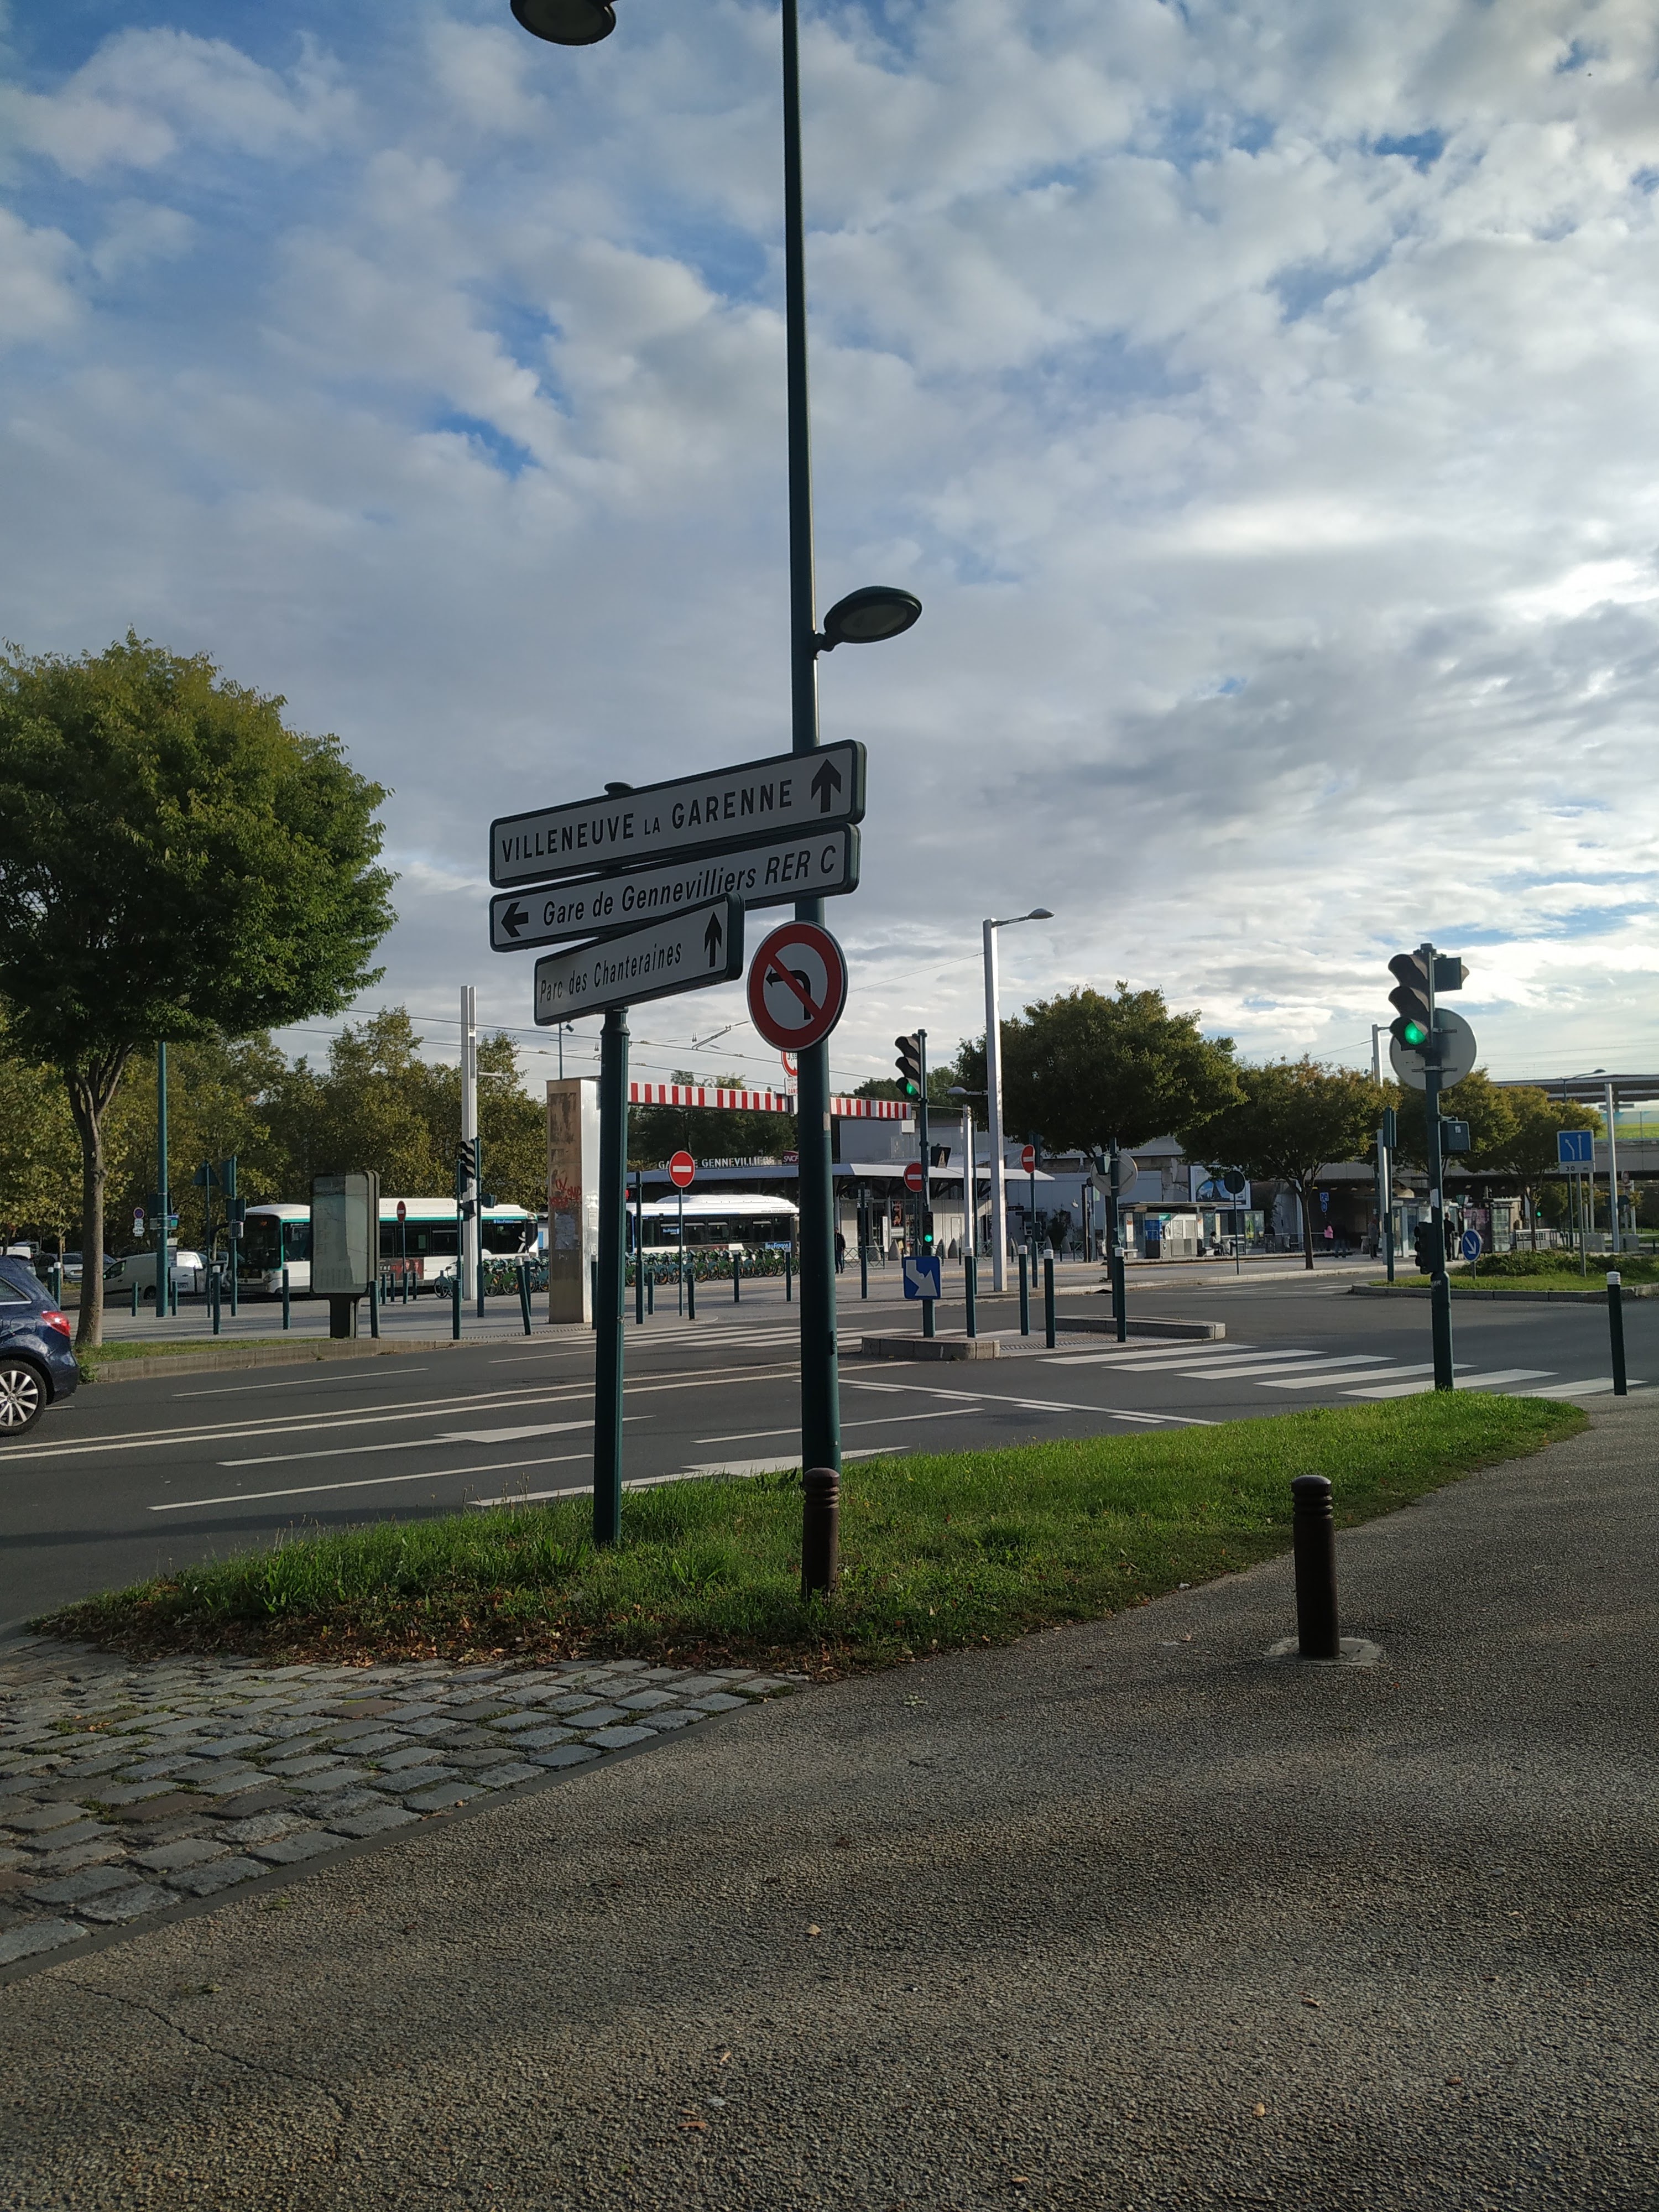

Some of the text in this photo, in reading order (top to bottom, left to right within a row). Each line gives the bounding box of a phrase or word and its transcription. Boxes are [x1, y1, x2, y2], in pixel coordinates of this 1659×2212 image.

[502, 779, 792, 862] VILLENEUVE LA GARENNE
[544, 845, 836, 926] Gare de Gennevilliers RER C
[540, 943, 681, 1003] Parc des Chanteraines
[658, 1160, 670, 1169] GA
[701, 1156, 774, 1167] GENNEVILLIERS
